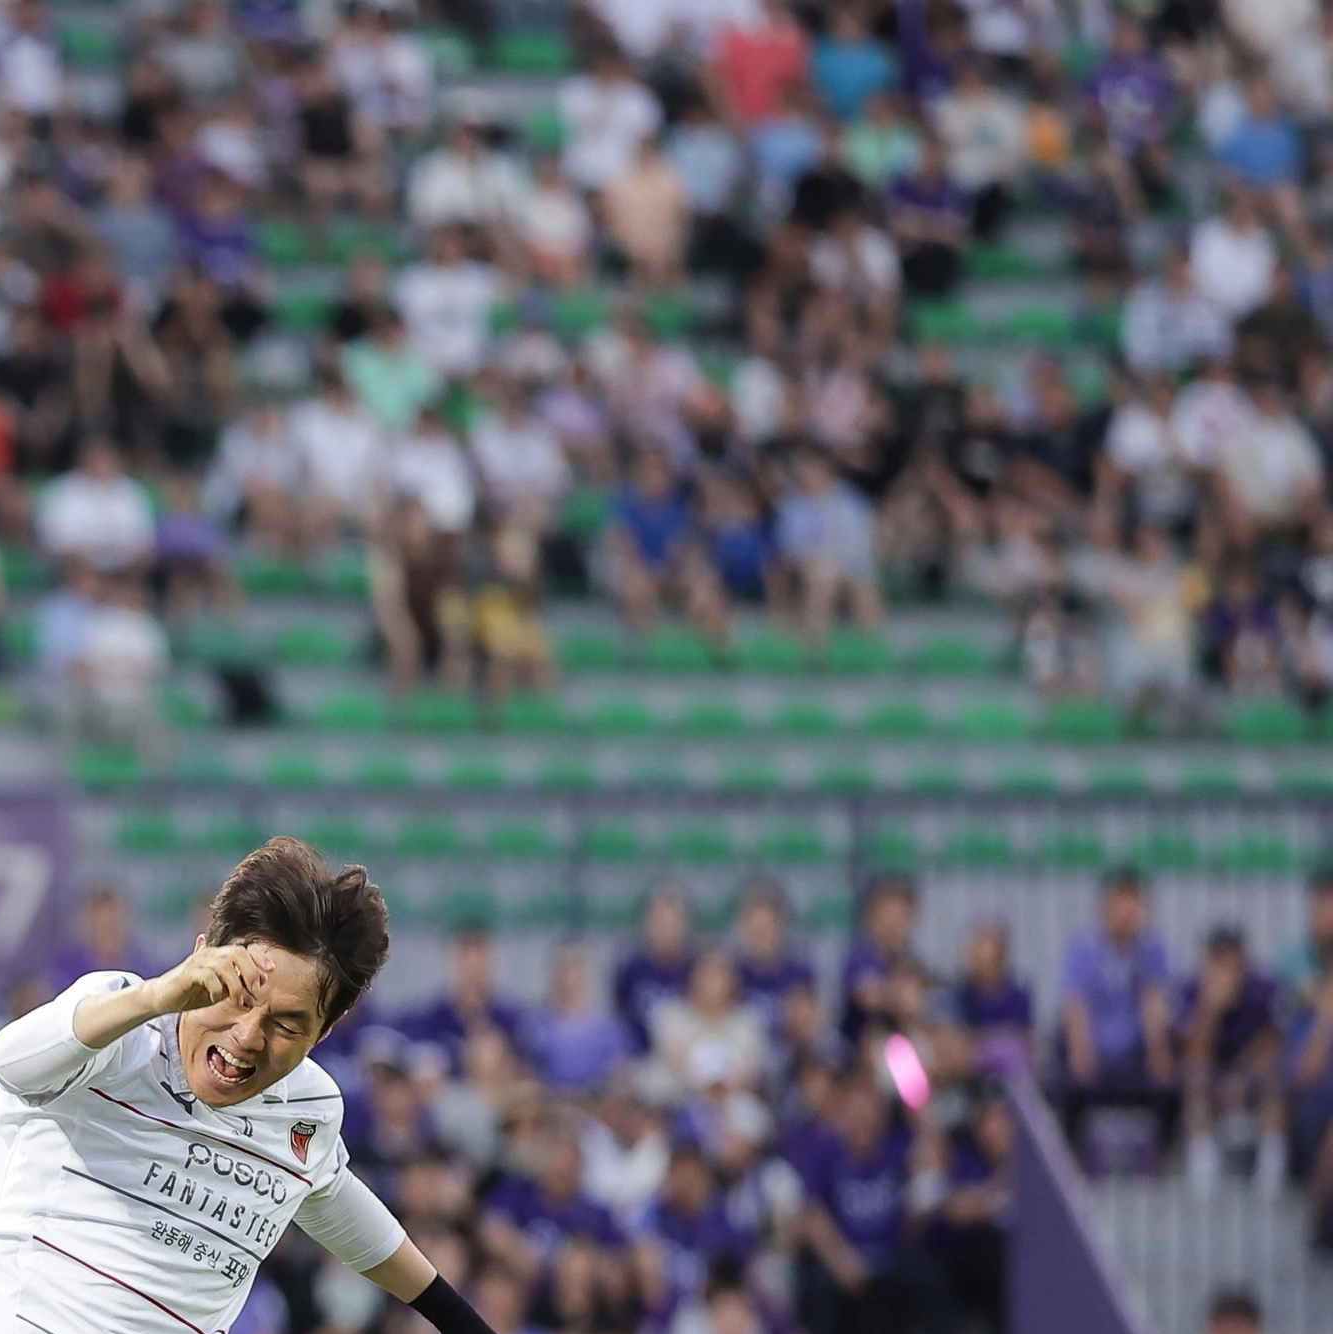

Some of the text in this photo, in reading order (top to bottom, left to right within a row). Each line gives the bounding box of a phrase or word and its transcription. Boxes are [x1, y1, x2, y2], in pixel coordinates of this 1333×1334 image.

[184, 1142, 287, 1205] posco
[151, 1220, 250, 1288] 환동해 중심 포항
